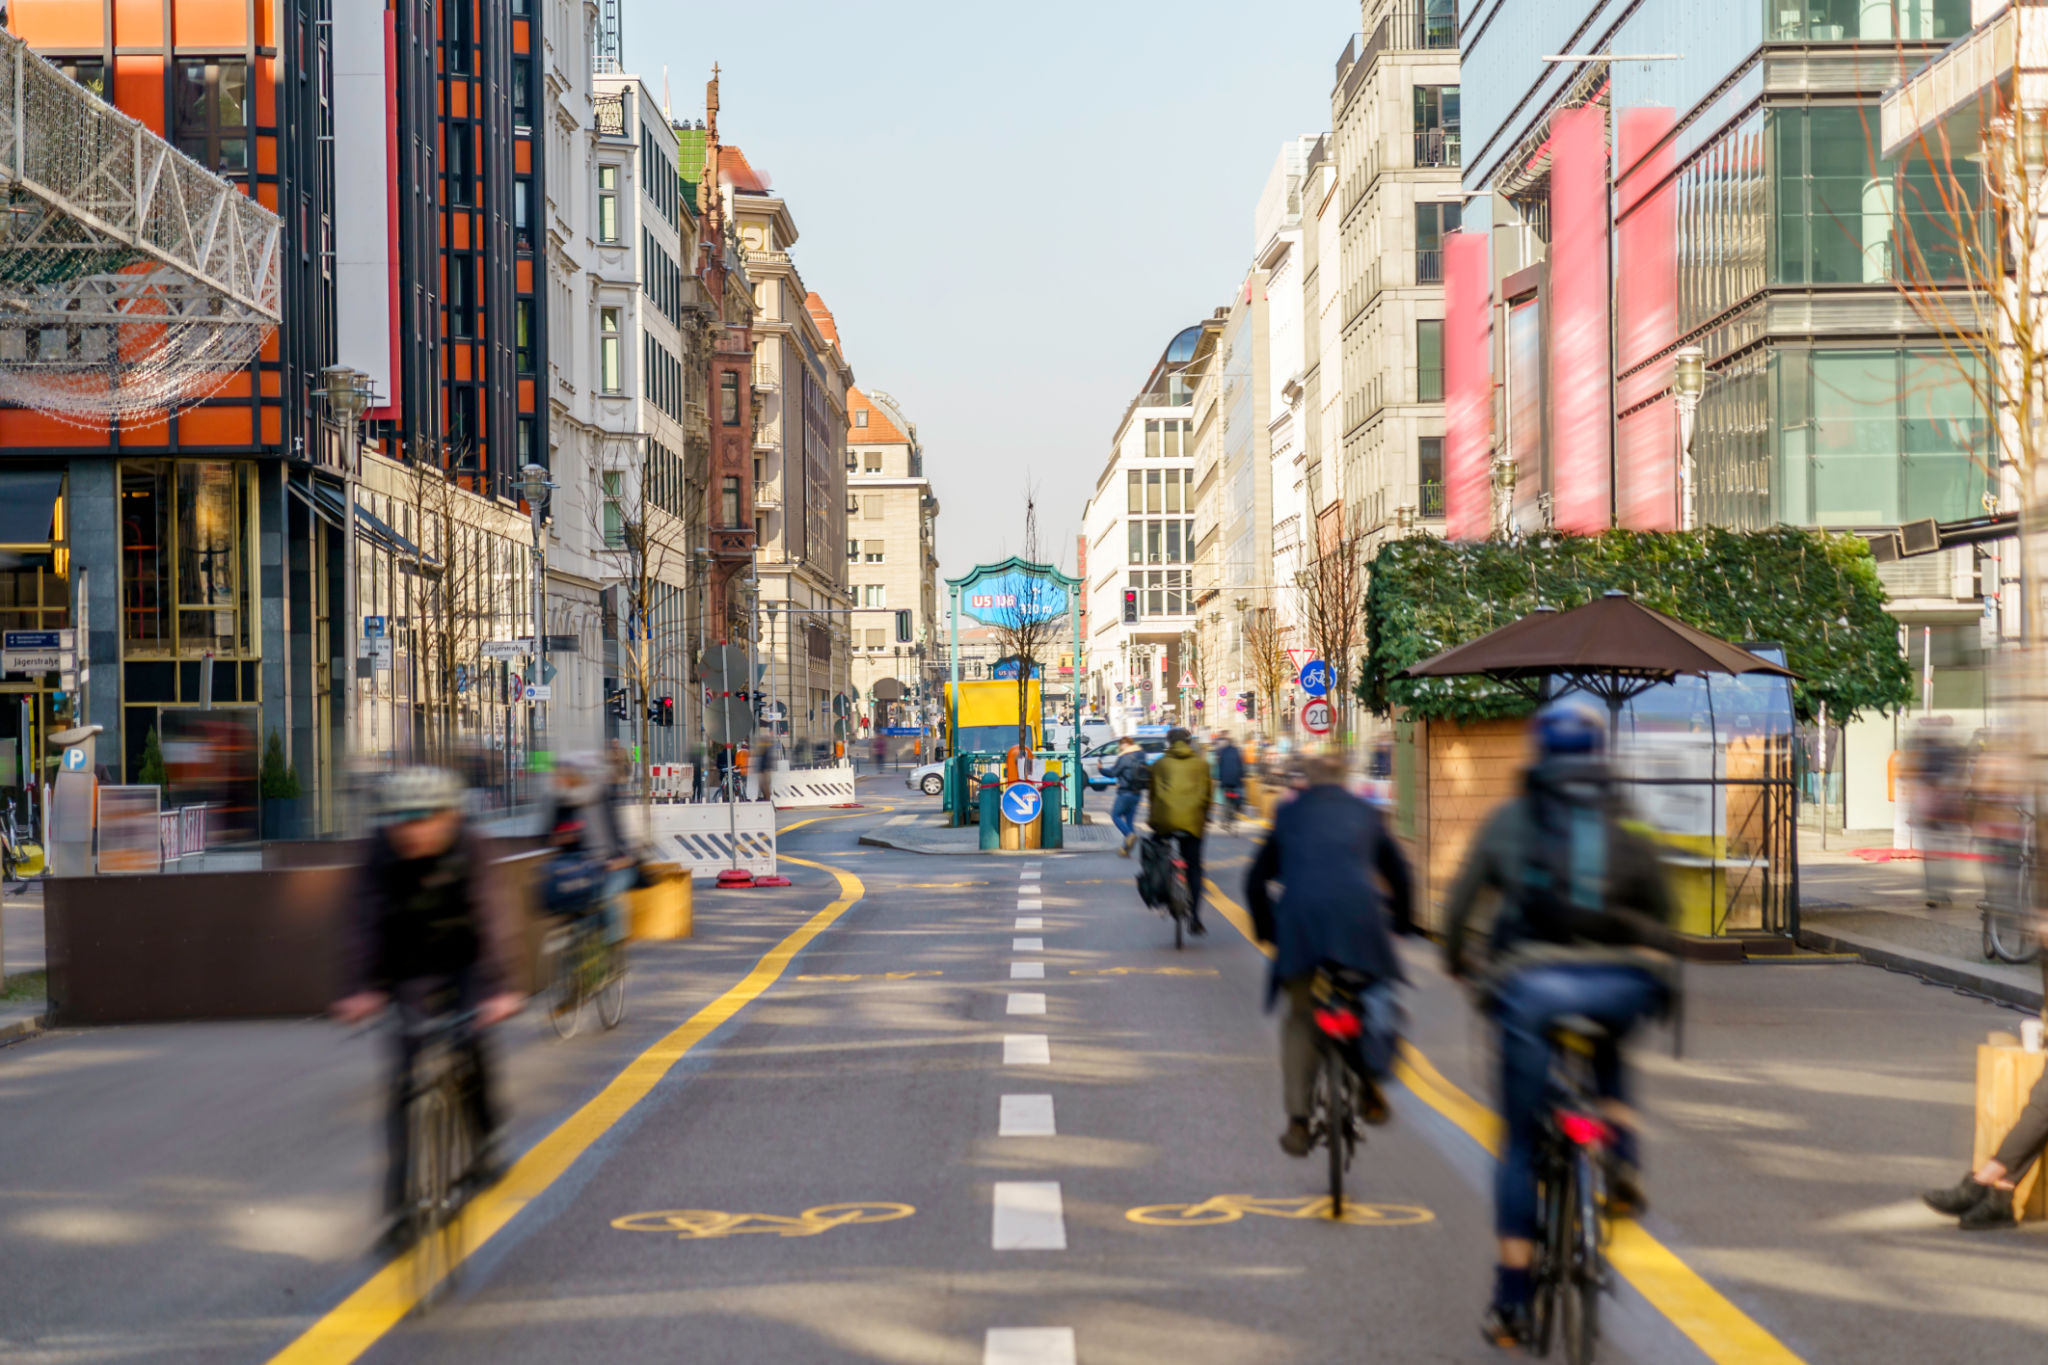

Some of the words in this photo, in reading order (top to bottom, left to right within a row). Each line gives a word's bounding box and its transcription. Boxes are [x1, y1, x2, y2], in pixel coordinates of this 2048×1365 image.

[974, 596, 991, 606] U5
[14, 656, 59, 668] Jägerstraße
[1310, 709, 1329, 725] 20
[70, 749, 84, 769] P
